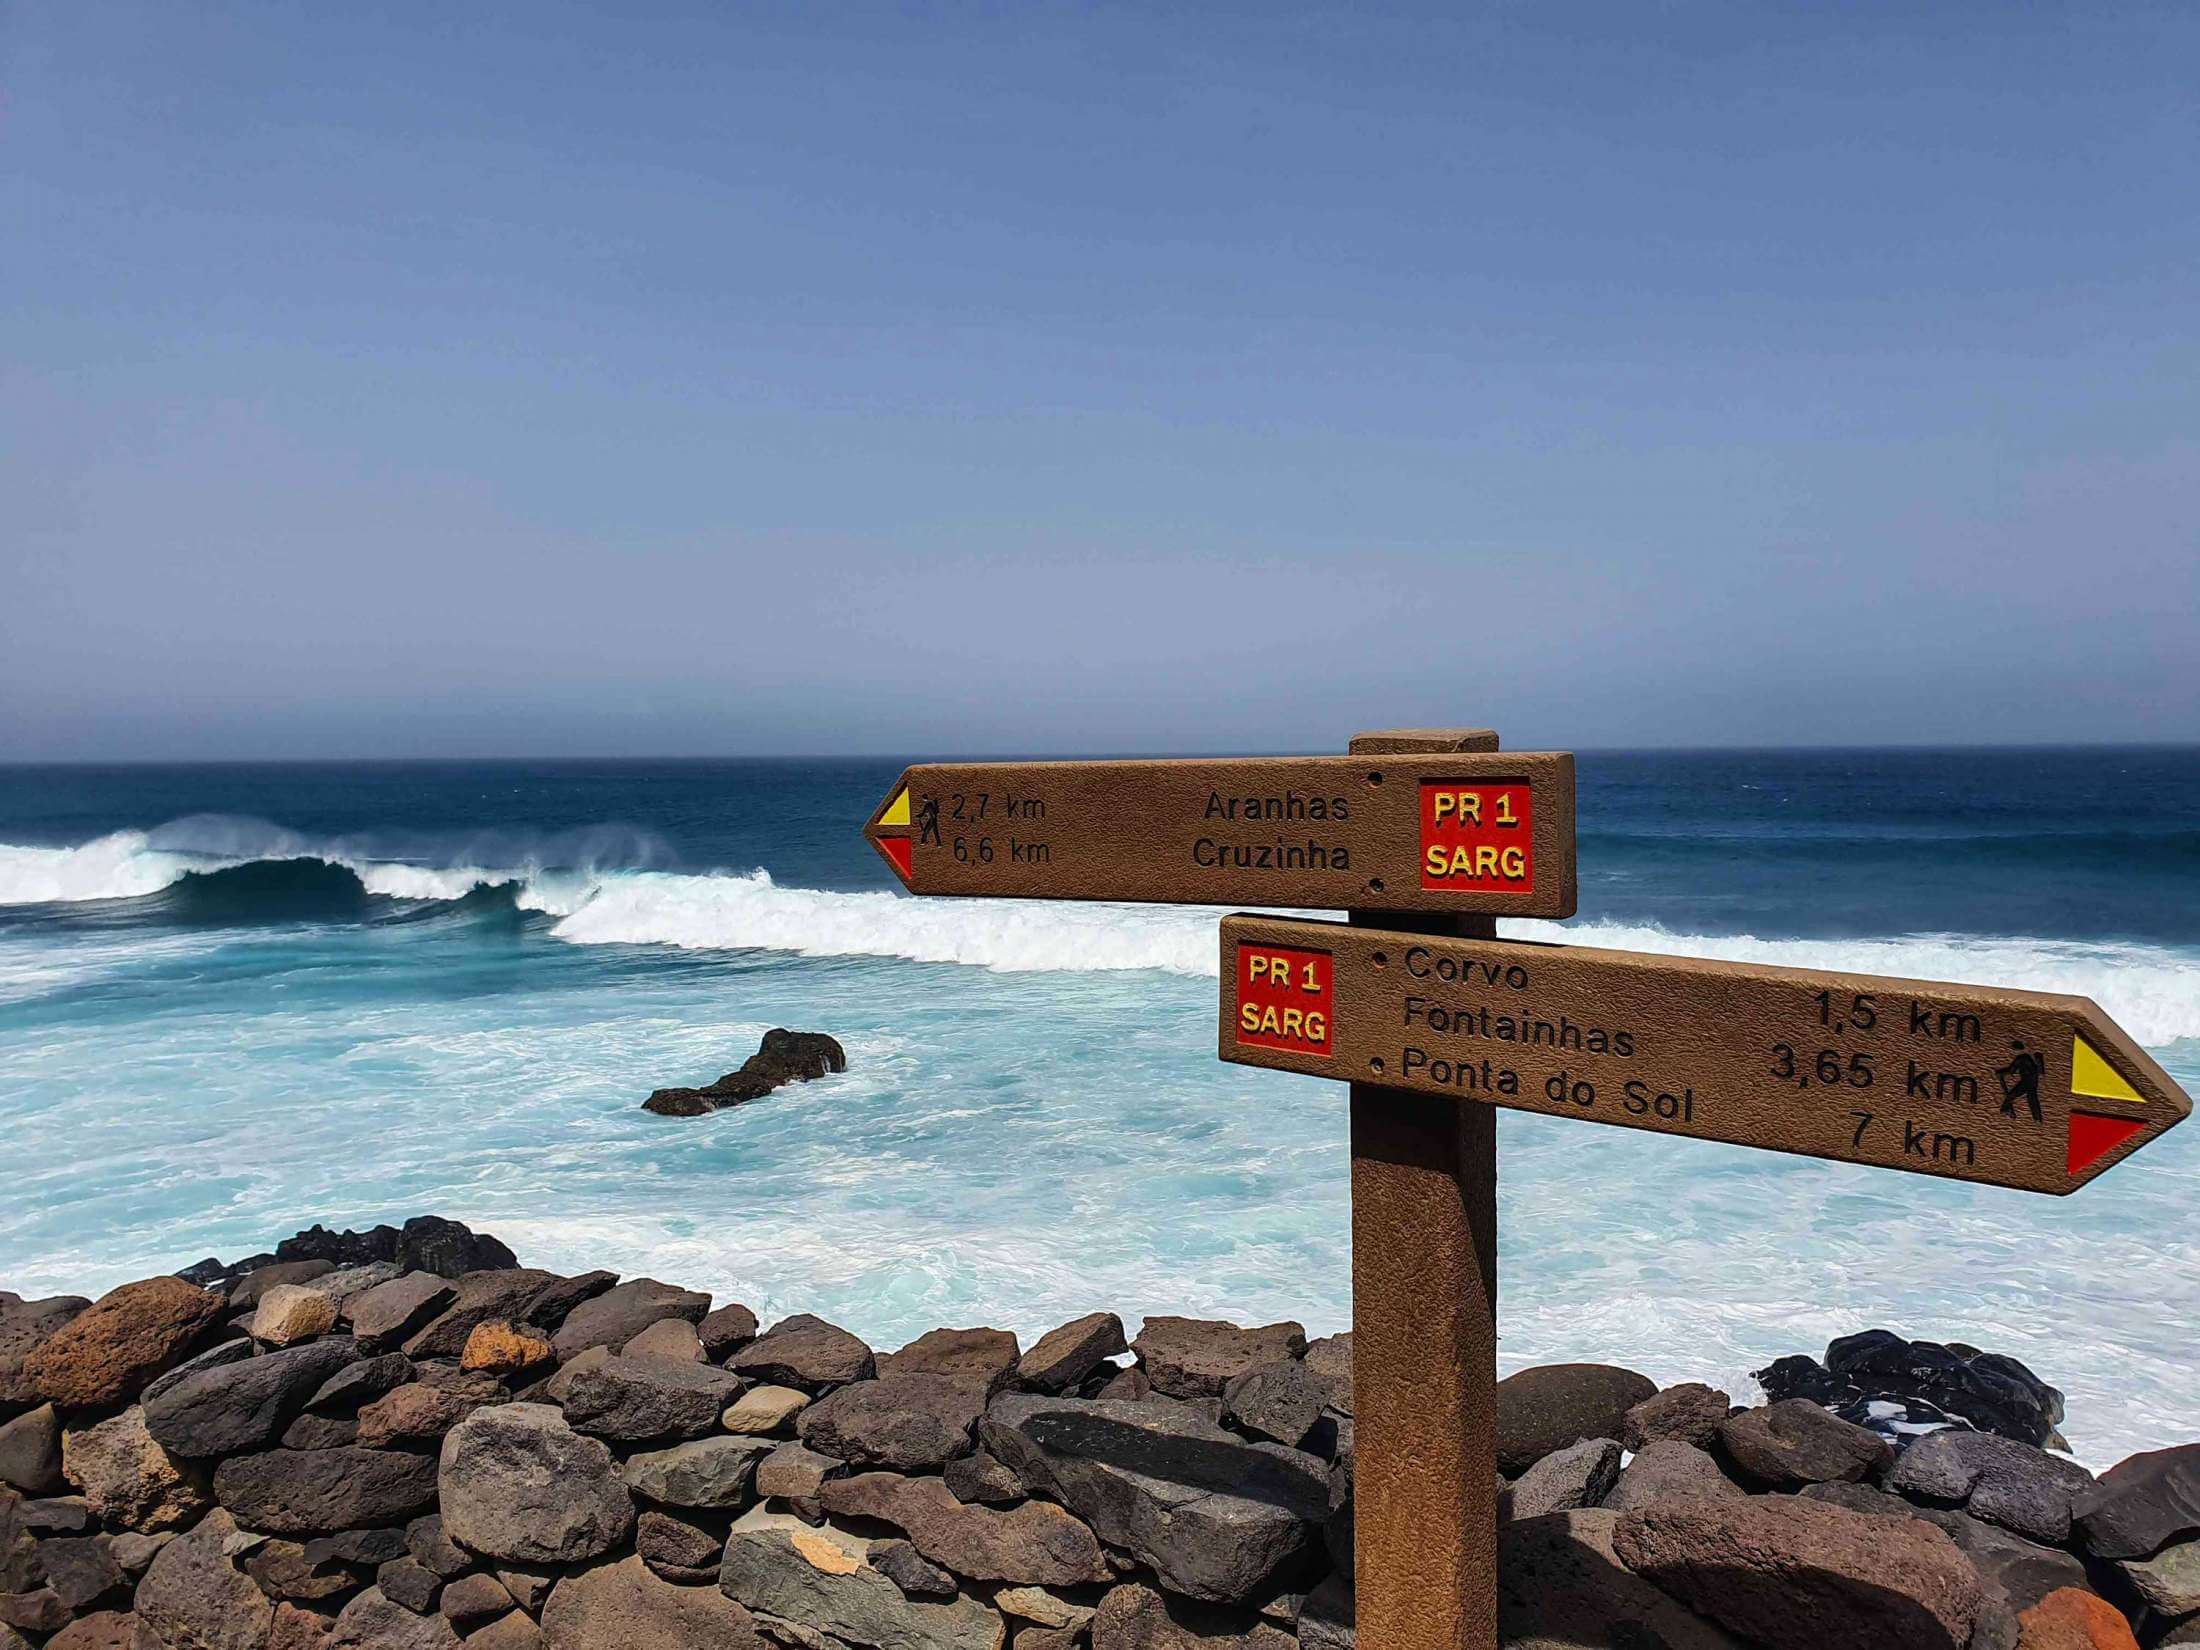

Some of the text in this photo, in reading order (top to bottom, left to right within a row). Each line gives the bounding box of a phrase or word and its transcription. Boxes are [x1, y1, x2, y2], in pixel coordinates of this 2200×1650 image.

[951, 790, 1350, 823] 2,7 km Aranhas
[1434, 791, 1519, 827] PR 1
[953, 836, 1350, 871] 6,6 km Cruzinha
[1425, 844, 1526, 880] SARG
[1249, 954, 1322, 993] PR 1
[1404, 945, 1981, 1044] Corvo 1,5 km
[1240, 1001, 1326, 1044] SARG
[1403, 998, 1979, 1105] Fontainhas 3,65 km
[1401, 1046, 1976, 1167] Ponta do Sol 7 km
